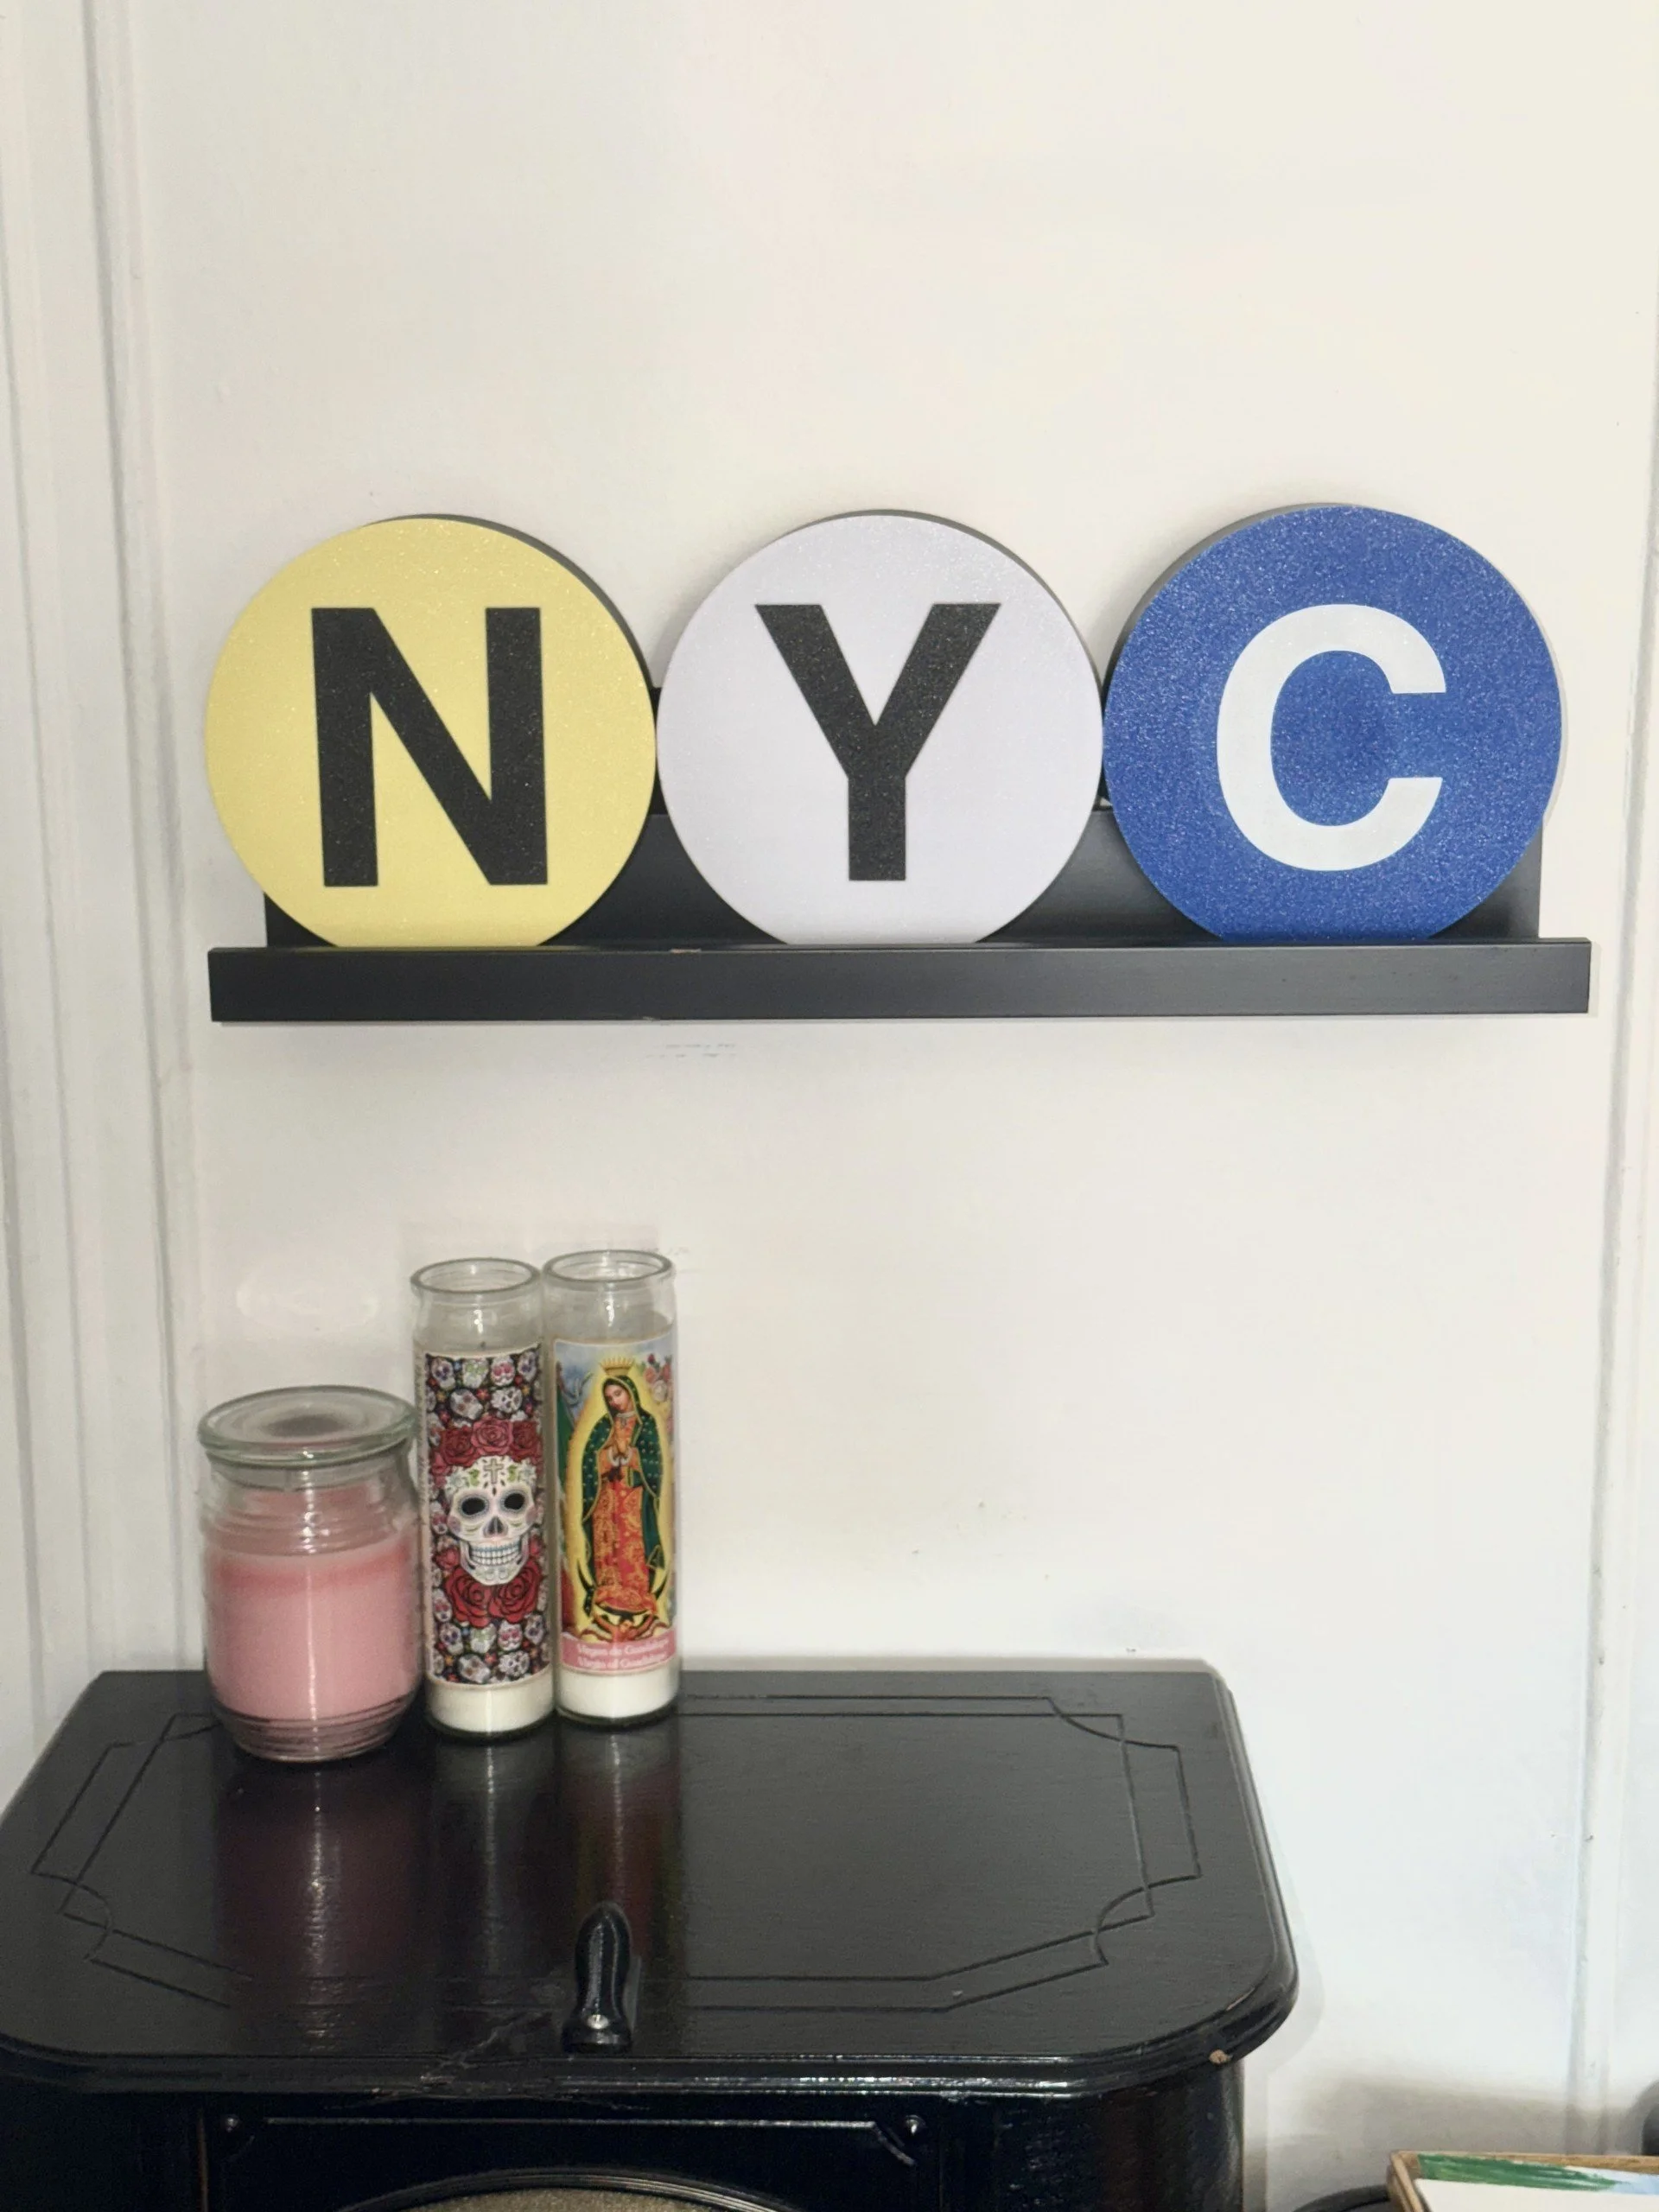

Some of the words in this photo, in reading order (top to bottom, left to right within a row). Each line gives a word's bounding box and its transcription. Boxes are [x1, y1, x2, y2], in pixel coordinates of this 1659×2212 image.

[312, 608, 547, 887] N
[756, 604, 1000, 880] Y
[1217, 604, 1447, 872] C
